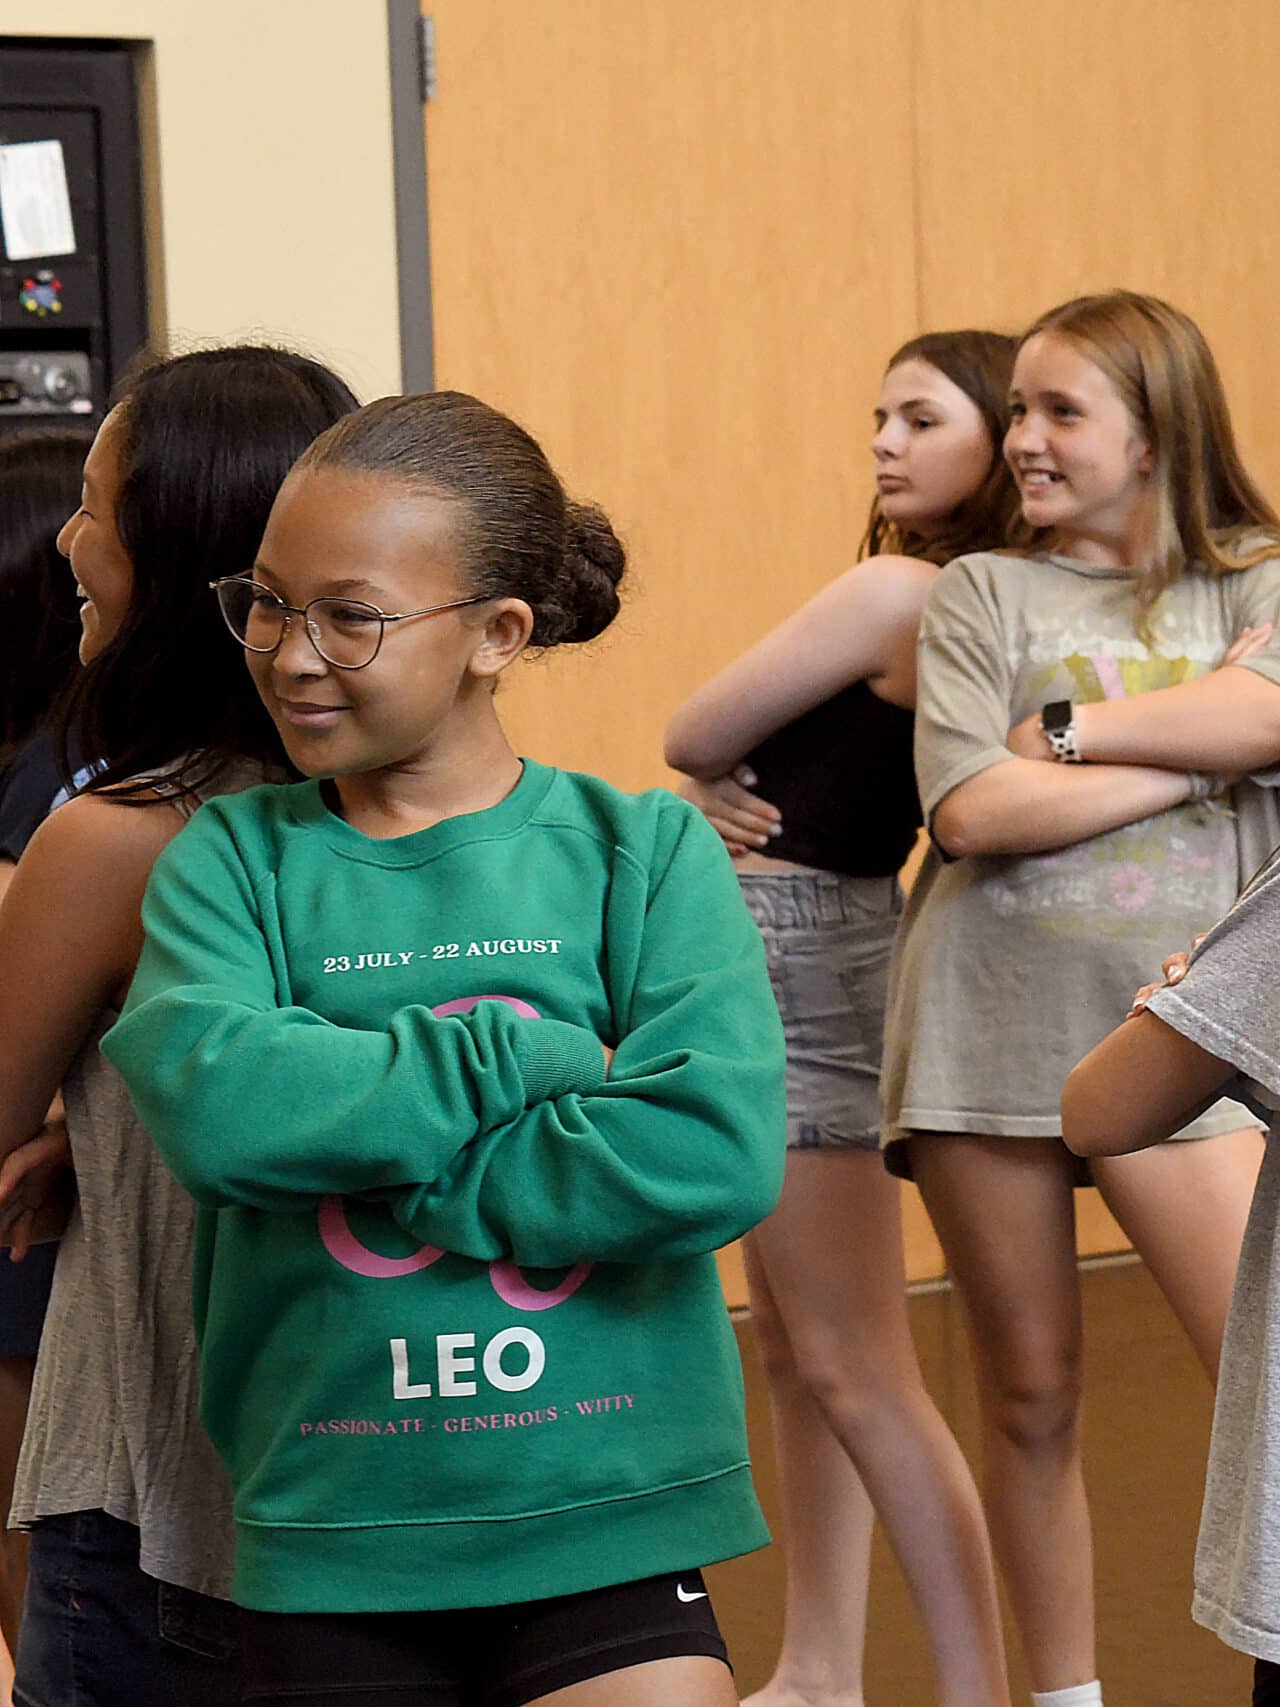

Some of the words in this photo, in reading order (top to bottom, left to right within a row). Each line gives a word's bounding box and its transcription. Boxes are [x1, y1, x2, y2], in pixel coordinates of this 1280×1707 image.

[322, 955, 351, 974] 23
[354, 951, 415, 971] JULY
[431, 943, 460, 960] 22
[465, 938, 563, 958] AUGUST
[389, 1325, 547, 1400] LEO
[299, 1418, 426, 1436] PASSIONATE
[443, 1405, 558, 1433] GENEROUS
[575, 1393, 636, 1416] WITTY
